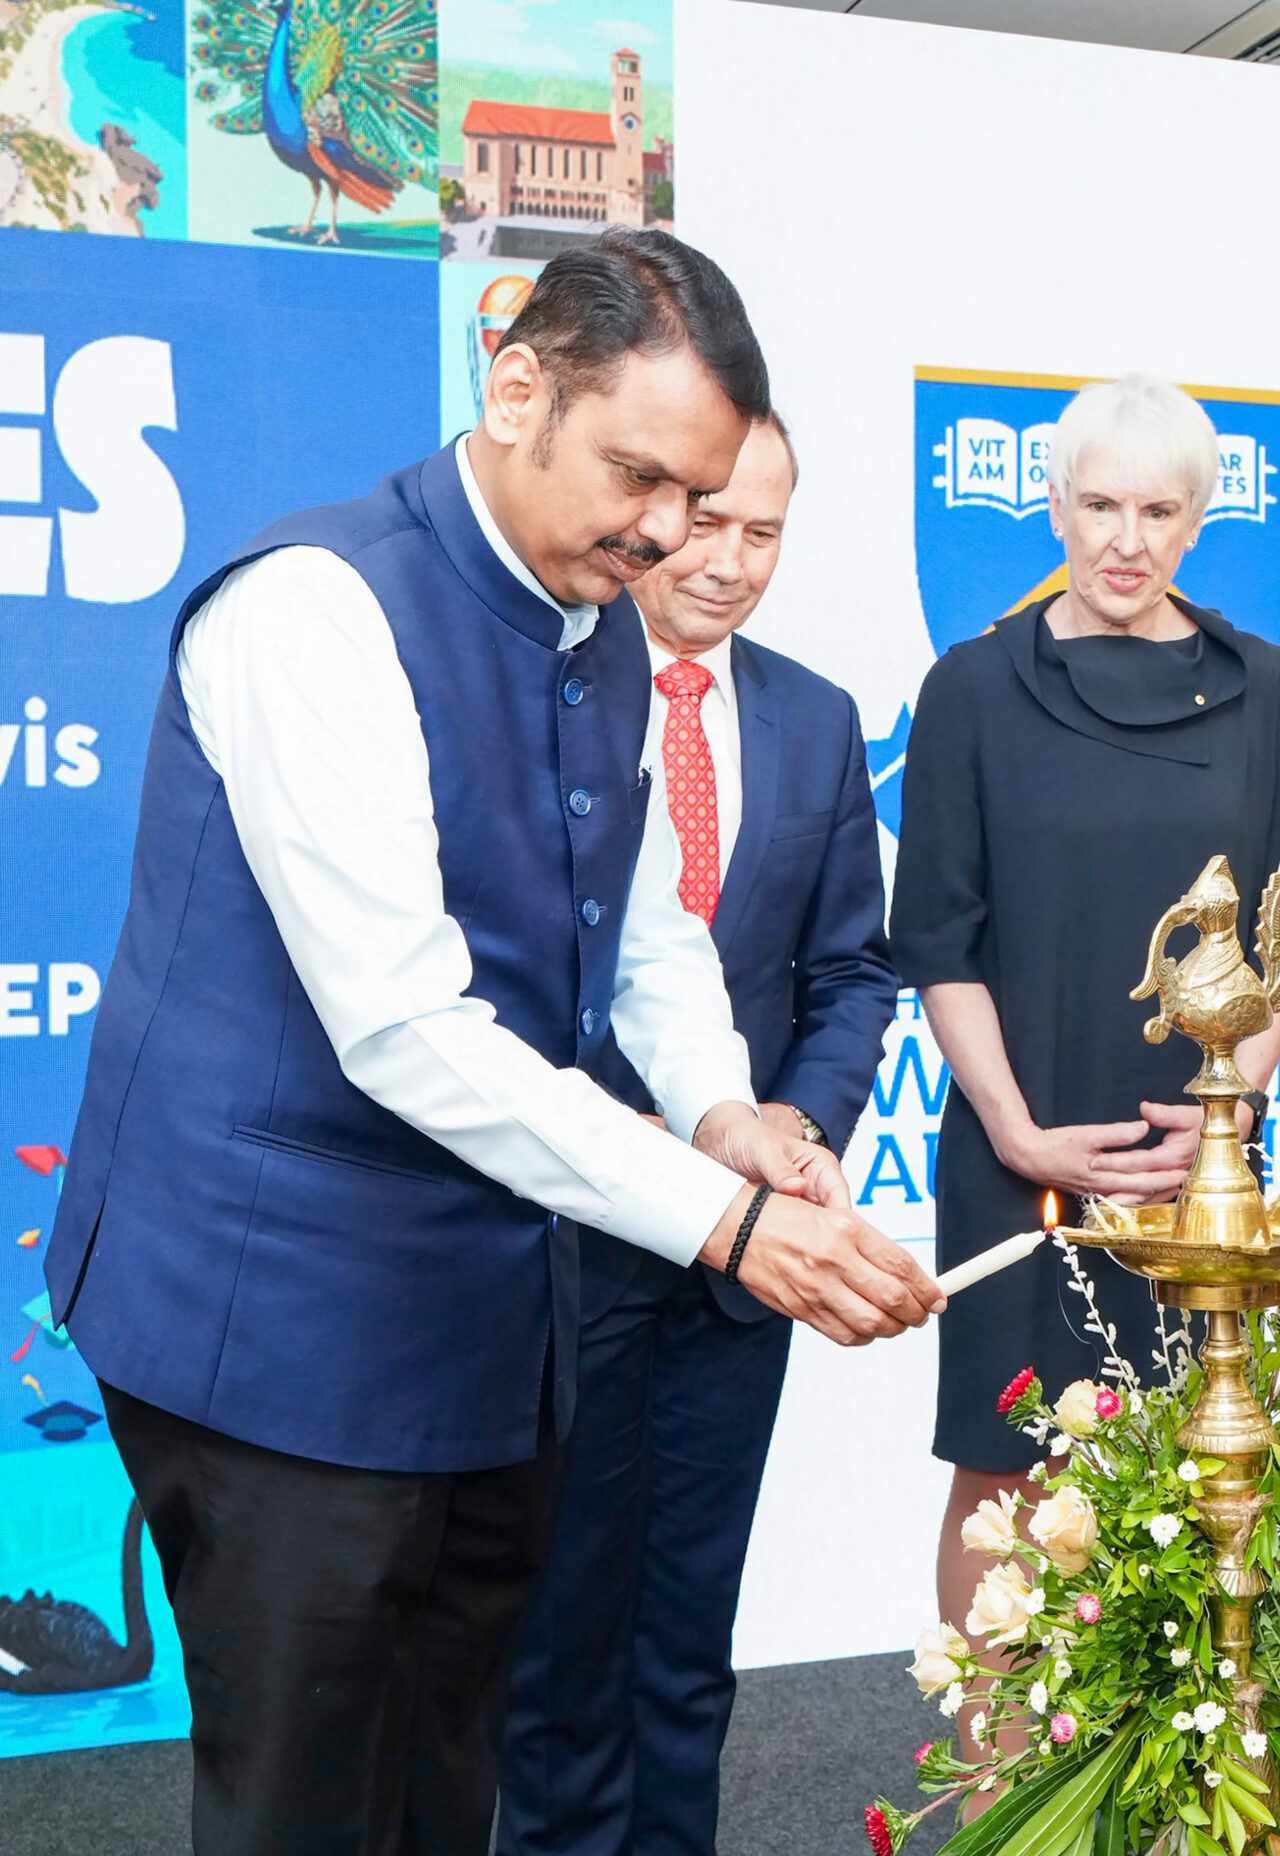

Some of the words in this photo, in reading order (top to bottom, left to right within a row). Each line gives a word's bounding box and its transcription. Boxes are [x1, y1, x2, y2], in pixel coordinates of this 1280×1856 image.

[968, 438, 1006, 458] VIT
[968, 462, 1004, 481] AM
[1217, 475, 1247, 494] ES
[0, 963, 100, 1036] EP
